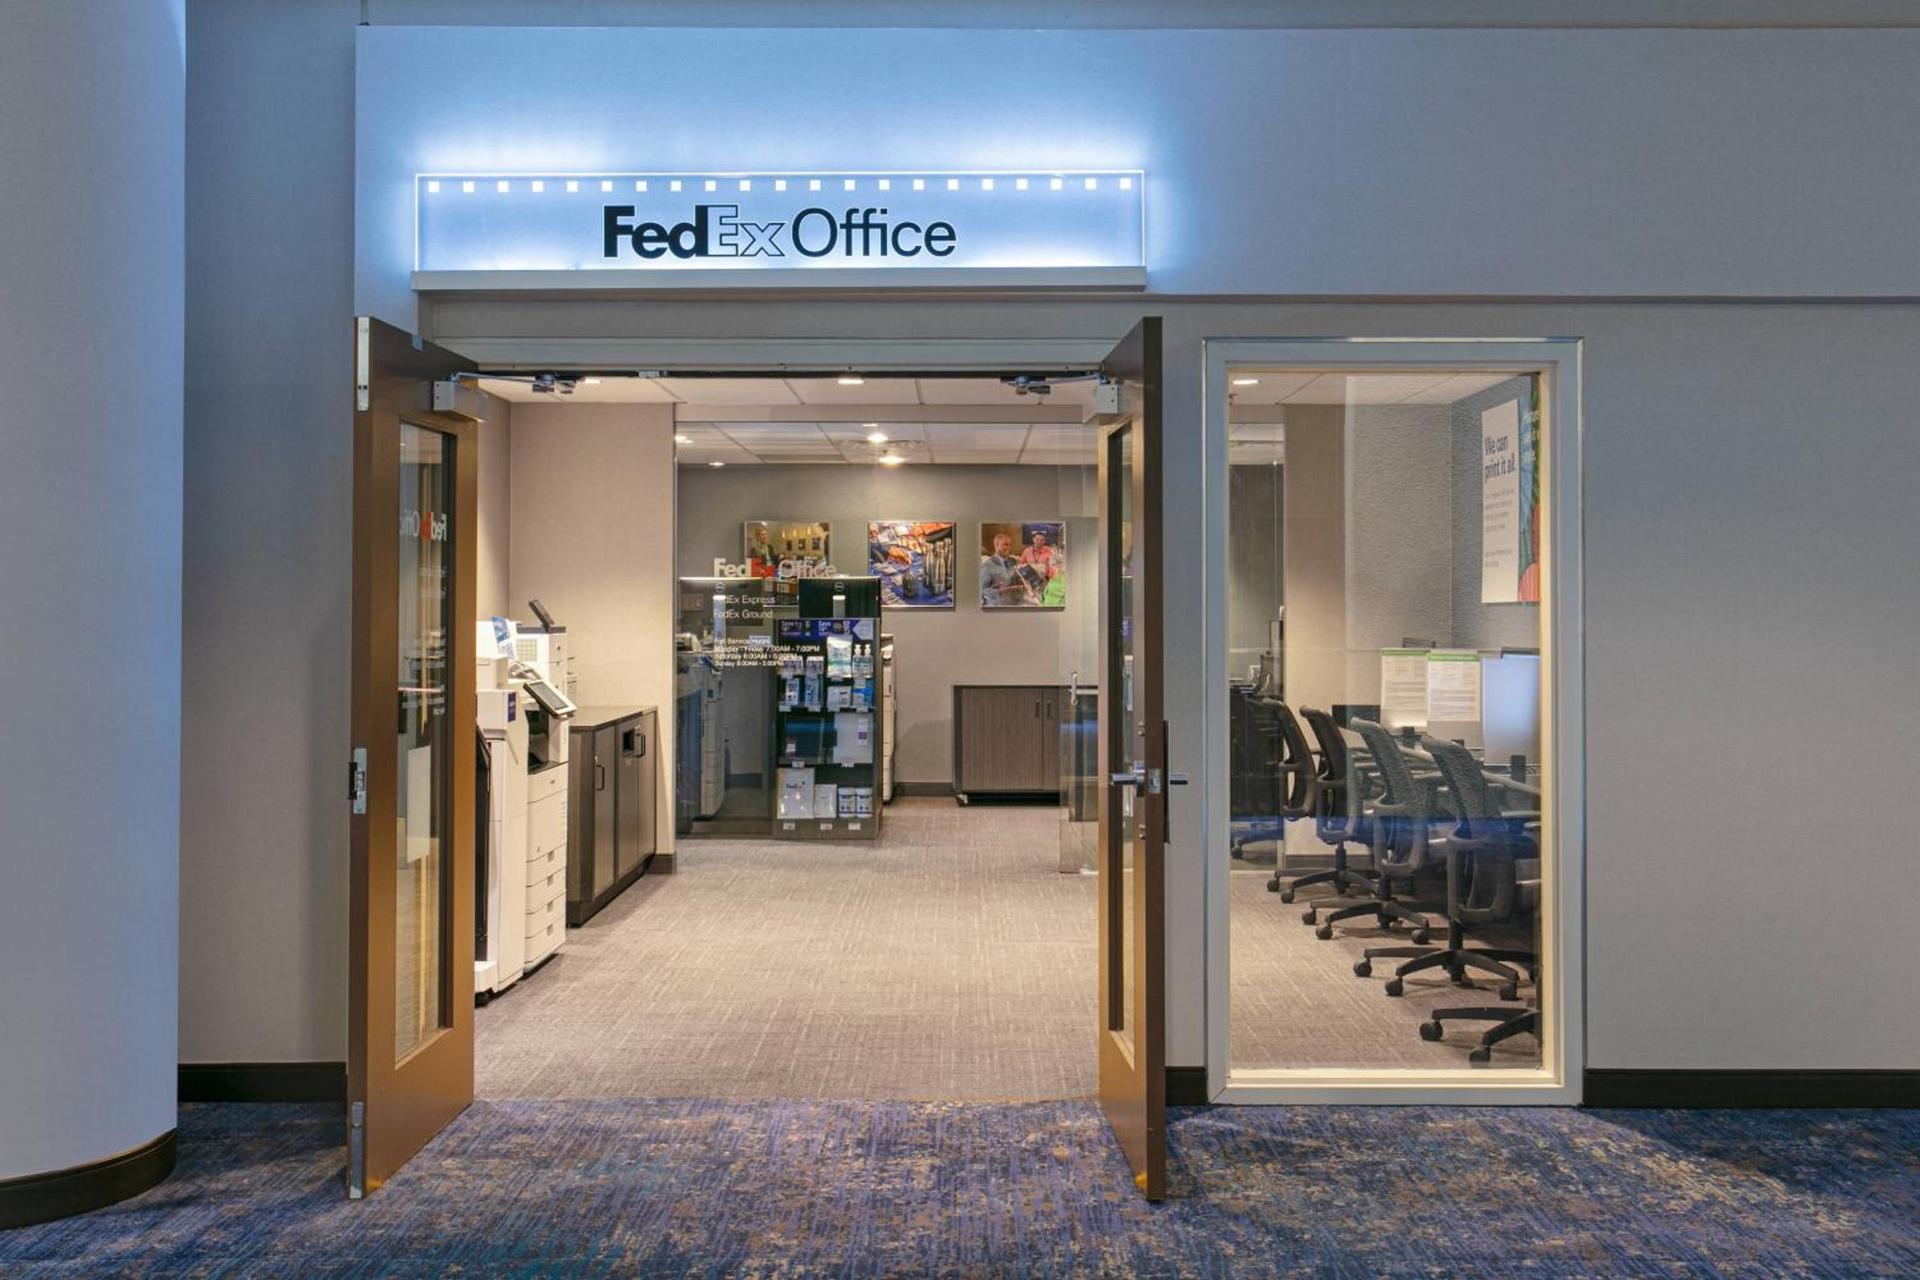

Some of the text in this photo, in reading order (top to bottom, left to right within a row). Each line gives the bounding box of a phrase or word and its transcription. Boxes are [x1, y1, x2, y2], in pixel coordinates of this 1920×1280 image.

[603, 204, 957, 259] FedEx Office
[1484, 435, 1508, 456] We can
[1484, 458, 1500, 484] print
[713, 557, 838, 579] FedEx Office
[741, 595, 776, 605] Express
[741, 609, 773, 619] Ground
